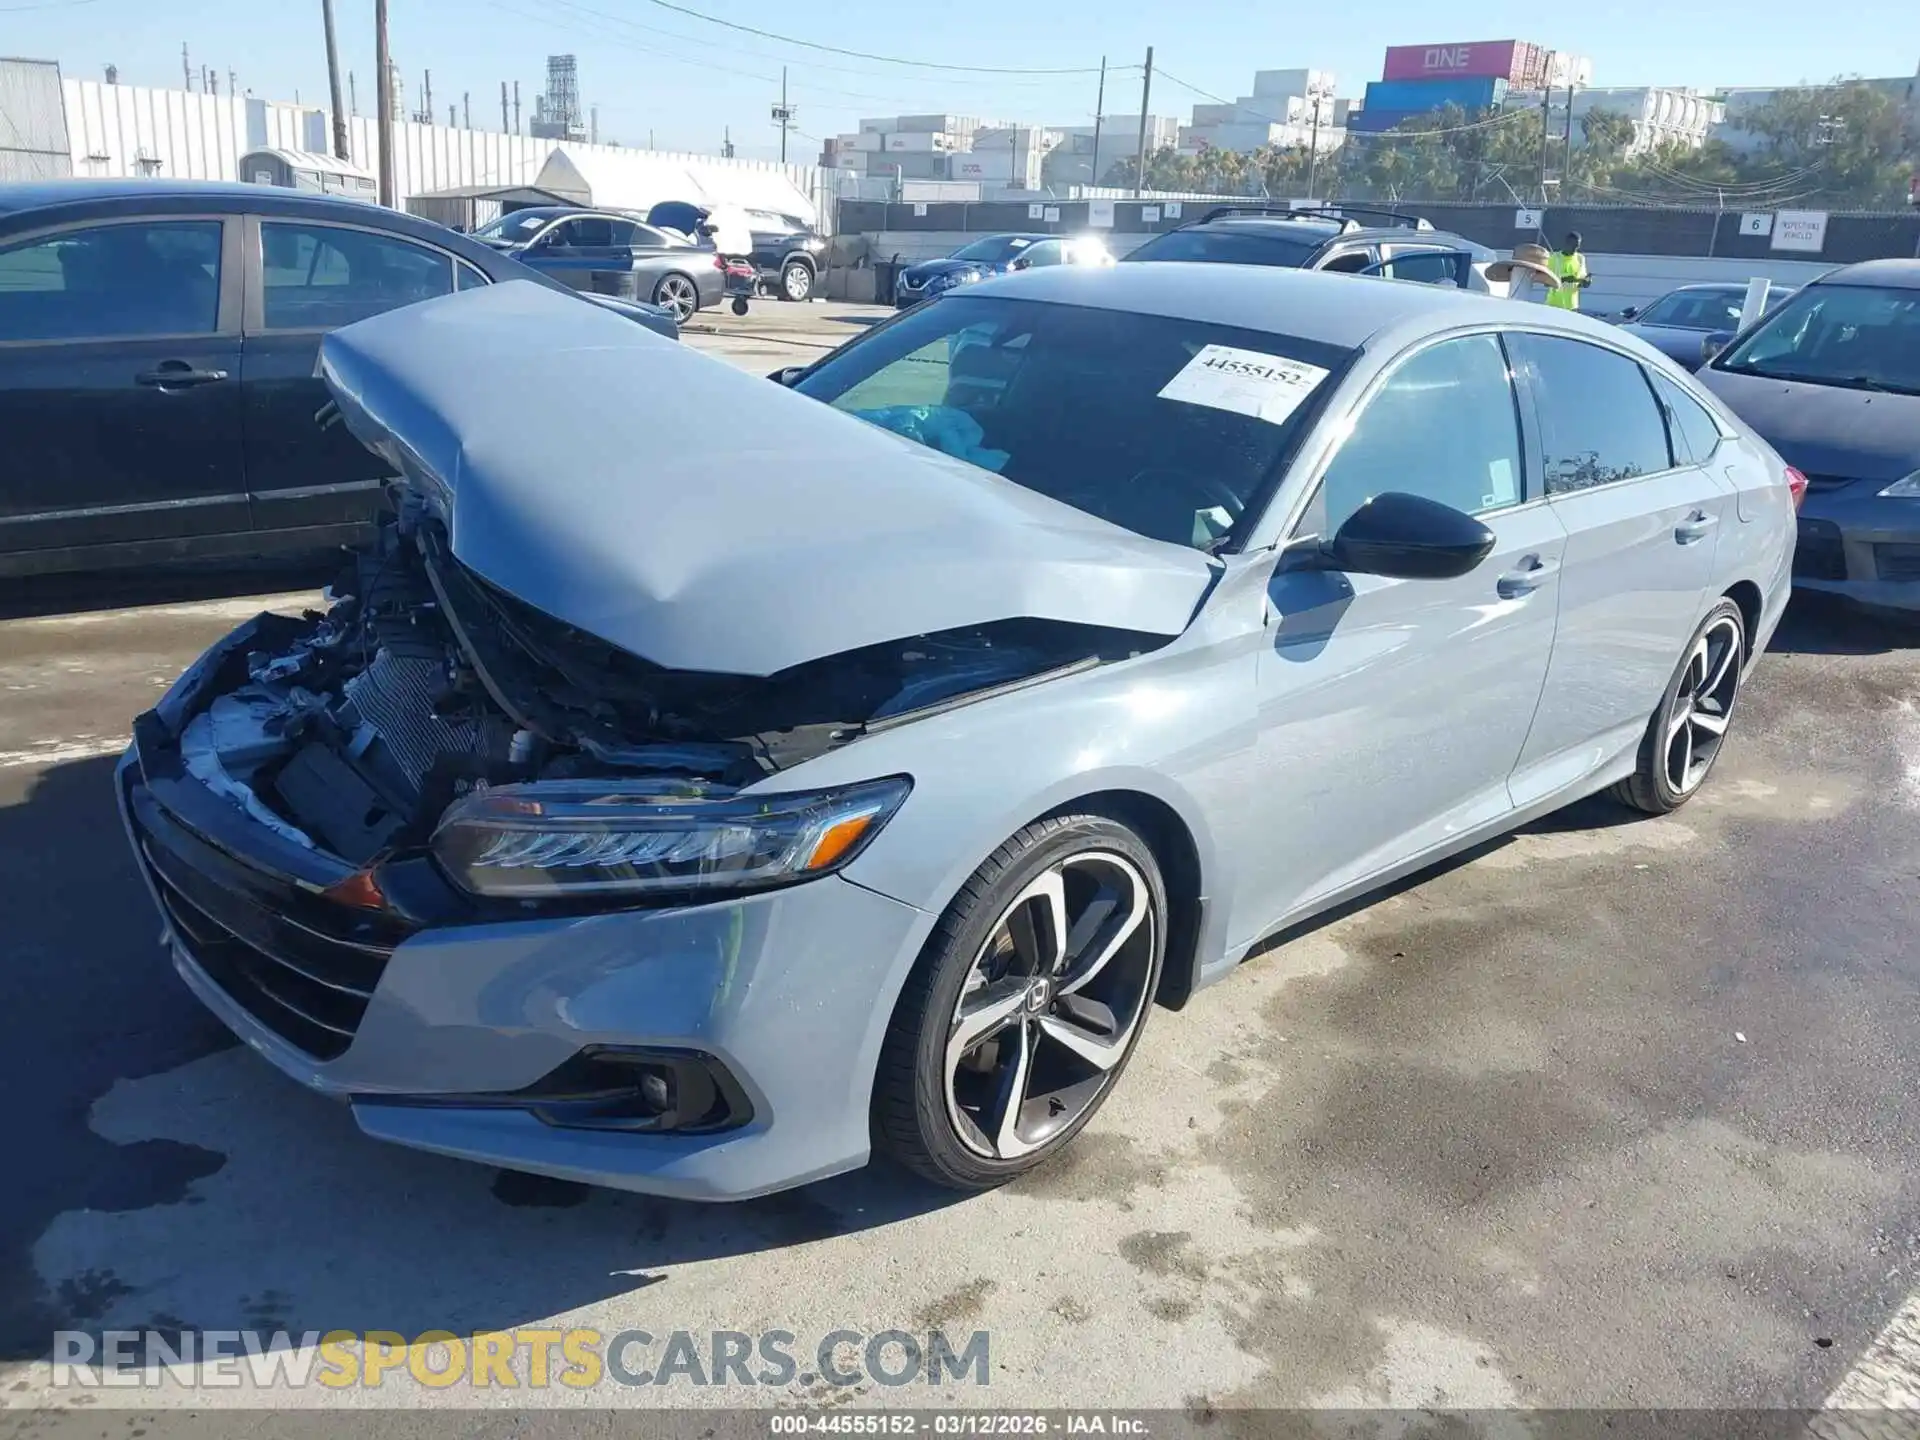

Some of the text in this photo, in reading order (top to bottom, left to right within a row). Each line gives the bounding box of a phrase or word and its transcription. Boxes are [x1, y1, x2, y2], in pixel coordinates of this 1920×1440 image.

[1423, 48, 1471, 68] ONE
[1524, 214, 1532, 224] 5
[1752, 219, 1760, 230] 6
[1203, 358, 1302, 385] 44555152
